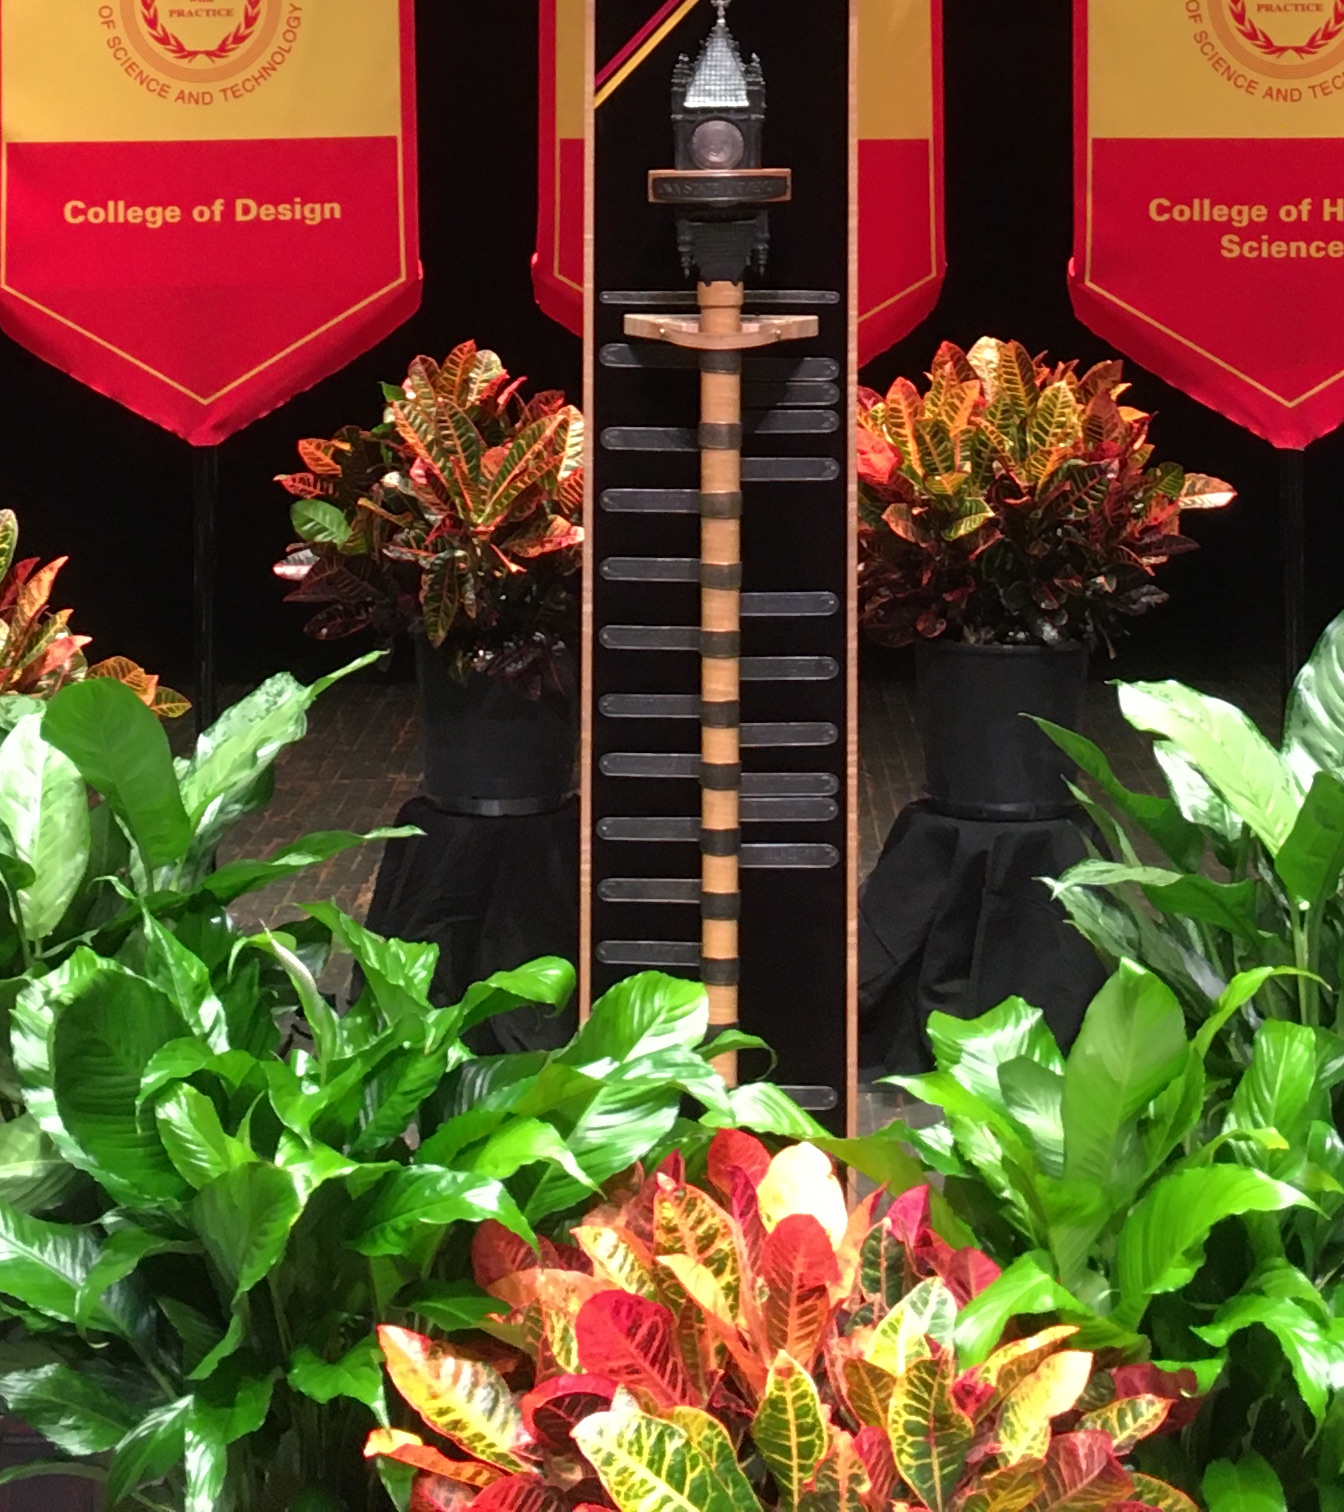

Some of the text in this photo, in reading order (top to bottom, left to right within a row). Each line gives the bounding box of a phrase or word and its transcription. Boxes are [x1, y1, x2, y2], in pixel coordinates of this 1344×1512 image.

[168, 8, 234, 18] PRACTICE
[1256, 3, 1324, 13] PRACTICE
[97, 3, 303, 106] OF SCIENCE AND TECHNOLOGY
[1193, 30, 1259, 96] SCIENCE
[1262, 86, 1303, 103] AND
[64, 198, 340, 228] College of Design
[1149, 198, 1267, 227] College
[1279, 198, 1311, 222] of
